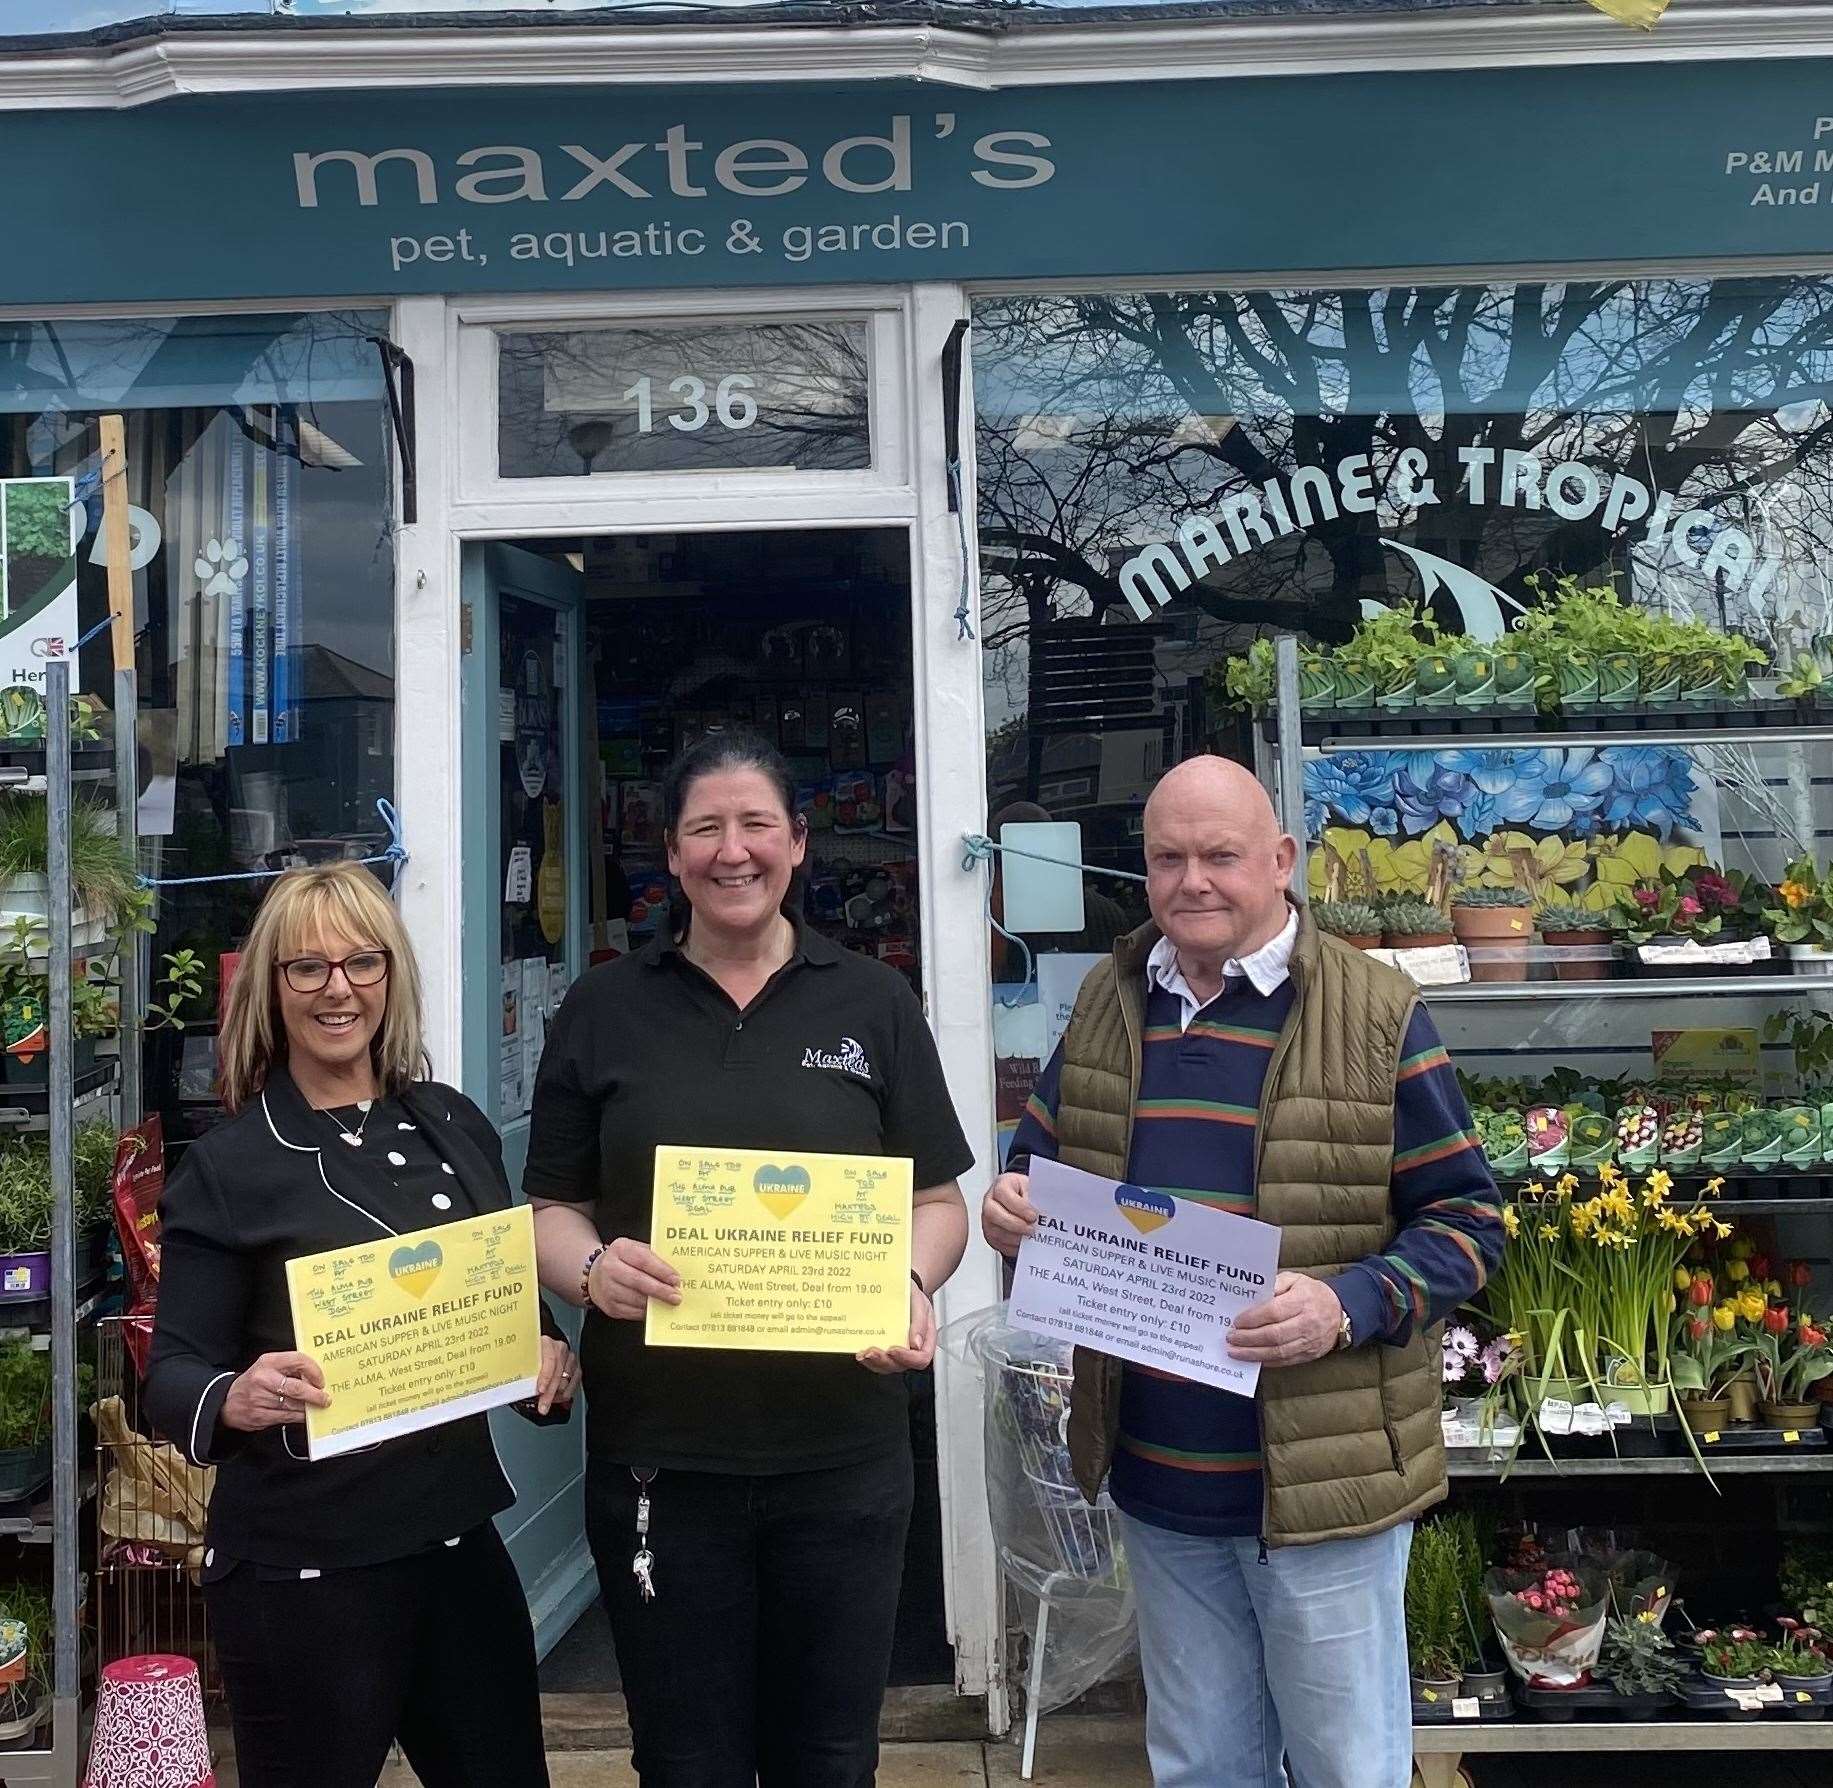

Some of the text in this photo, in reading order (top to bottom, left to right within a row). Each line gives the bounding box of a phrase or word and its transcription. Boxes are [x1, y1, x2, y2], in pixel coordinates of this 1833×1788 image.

[293, 113, 1056, 207] maxted's
[1725, 151, 1804, 174] P&M
[1750, 183, 1820, 206] And
[390, 216, 970, 271] pet, aquatic & garden
[623, 373, 758, 432] 136
[1119, 446, 1781, 621] MARINE & TROPICAL
[759, 1182, 805, 1194] UKRAINE
[1120, 1195, 1169, 1218] UKRAINE
[666, 1226, 893, 1245] DEAL UKRAINE RELIEF FUND
[672, 1245, 887, 1261] AMERICAN SUPPER & LIVE MUSIC NIGHT
[1037, 1213, 1265, 1287] EAL UKRAINE RELIEF FUND
[394, 1256, 440, 1277] UKRAINE
[708, 1262, 851, 1276] SATURDAY APRIL 23rd 2022
[1028, 1228, 1257, 1300] AMERICAN SUPPER & LIVE MUSIC NIGHT
[1063, 1255, 1216, 1306] SATURDAY APRIL 23rd 2022
[725, 1296, 754, 1307] Ticket
[757, 1297, 783, 1309] entry
[814, 1299, 831, 1308] £10
[738, 1280, 763, 1290] West
[802, 1282, 824, 1291] Deal
[827, 1282, 851, 1292] from
[856, 1283, 881, 1293] 19.00
[1028, 1264, 1049, 1280] THE
[1091, 1281, 1118, 1298] West
[1159, 1298, 1183, 1314] Deal
[1186, 1306, 1214, 1323] from
[1217, 1315, 1231, 1327] 19
[313, 1281, 522, 1347] DEAL UKRAINE RELIEF FUND
[322, 1300, 518, 1362] AMERICAN SUPPER & LIVE MUSIC NIGHT
[1077, 1294, 1107, 1313] Ticket
[1109, 1304, 1136, 1322] entry
[1170, 1319, 1191, 1335] £10
[331, 1379, 350, 1393] THE
[388, 1363, 411, 1377] West
[447, 1347, 466, 1361] Deal
[469, 1340, 490, 1354] from
[494, 1333, 516, 1347] 19.00
[358, 1325, 488, 1370] SATURDAY APRIL 23rd 2022
[379, 1380, 405, 1397] Ticket
[408, 1374, 431, 1391] entry
[459, 1361, 475, 1374] £10
